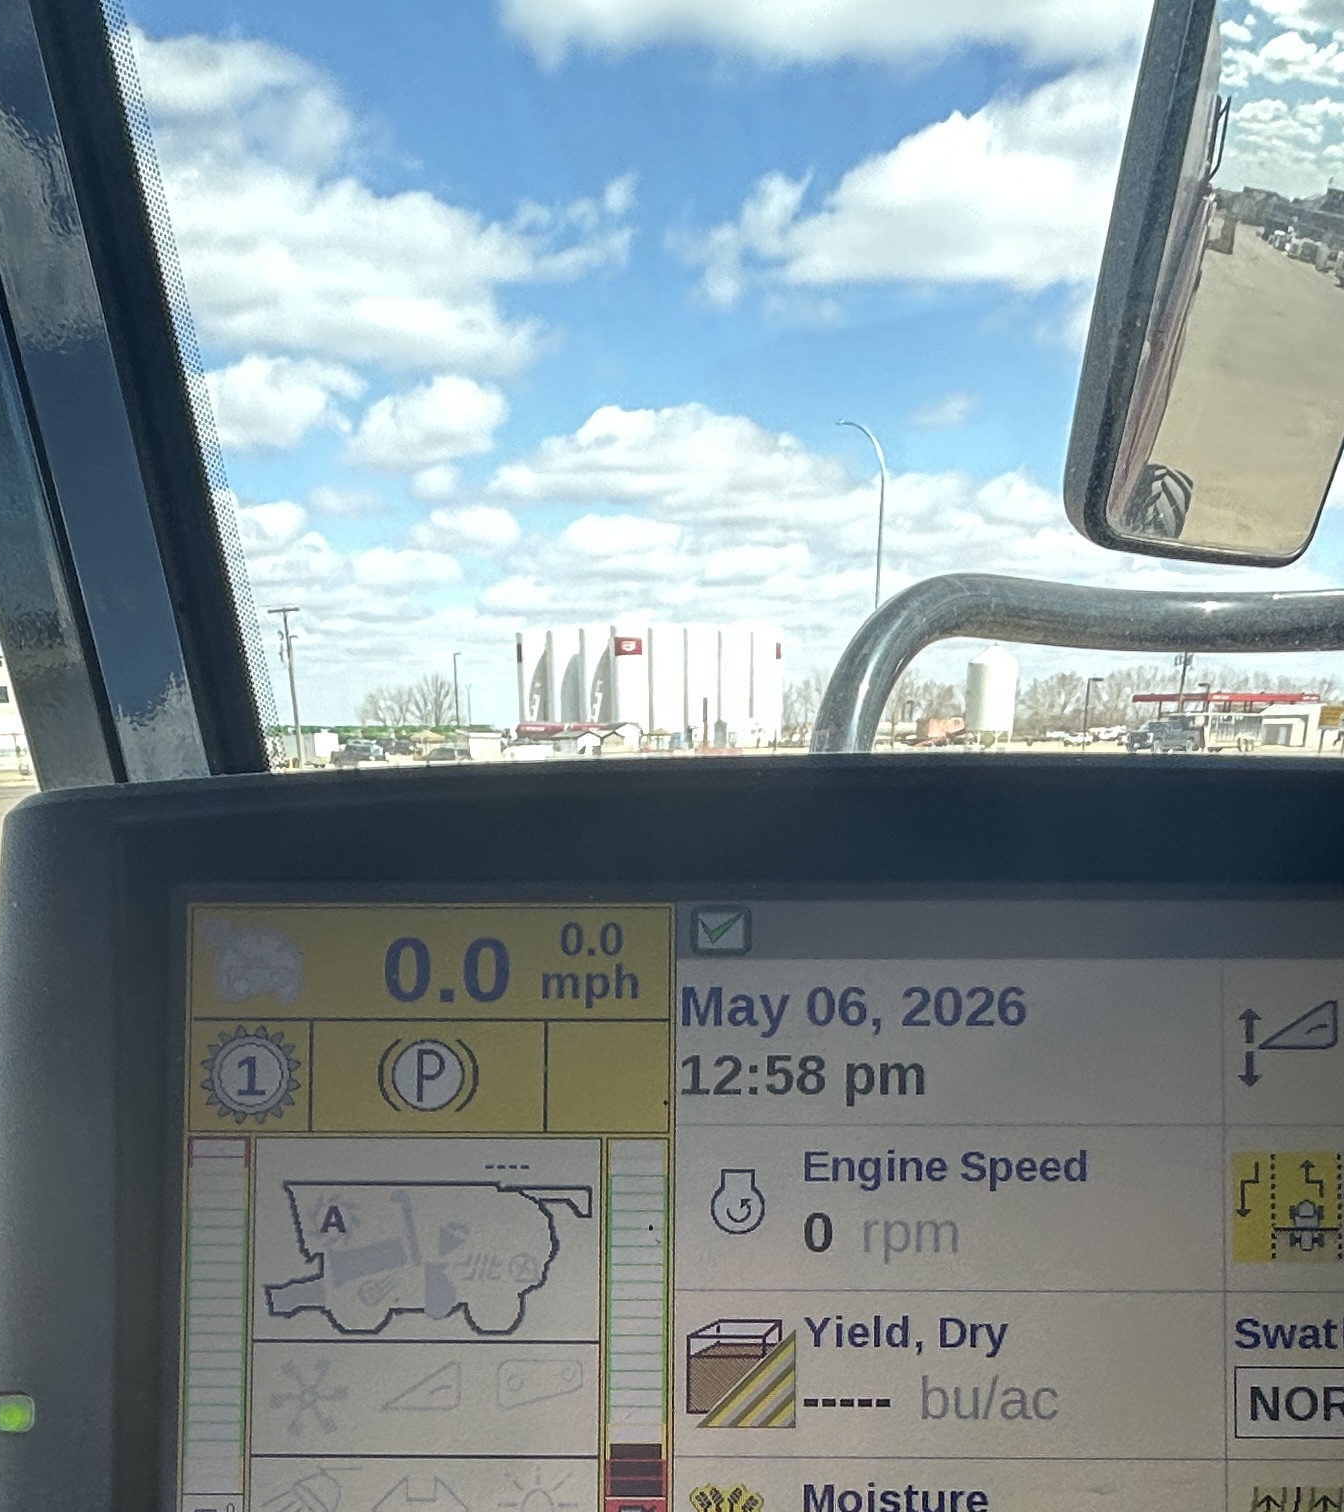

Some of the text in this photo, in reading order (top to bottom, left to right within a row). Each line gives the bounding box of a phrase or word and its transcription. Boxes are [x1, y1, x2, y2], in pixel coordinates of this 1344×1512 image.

[559, 921, 623, 957] 0.0
[384, 937, 510, 1003] 0.0
[541, 964, 639, 1008] mph
[681, 986, 1027, 1037] May 06, 2026
[236, 1057, 266, 1096] 1
[416, 1049, 446, 1102] P
[680, 1055, 926, 1107] 12:58 pm
[803, 1149, 1088, 1190] Engine Speed
[320, 1205, 346, 1233] A
[803, 1213, 959, 1264] 0 rpm
[803, 1315, 1009, 1357] Yield, Dry
[920, 1375, 1059, 1420] bu/ac
